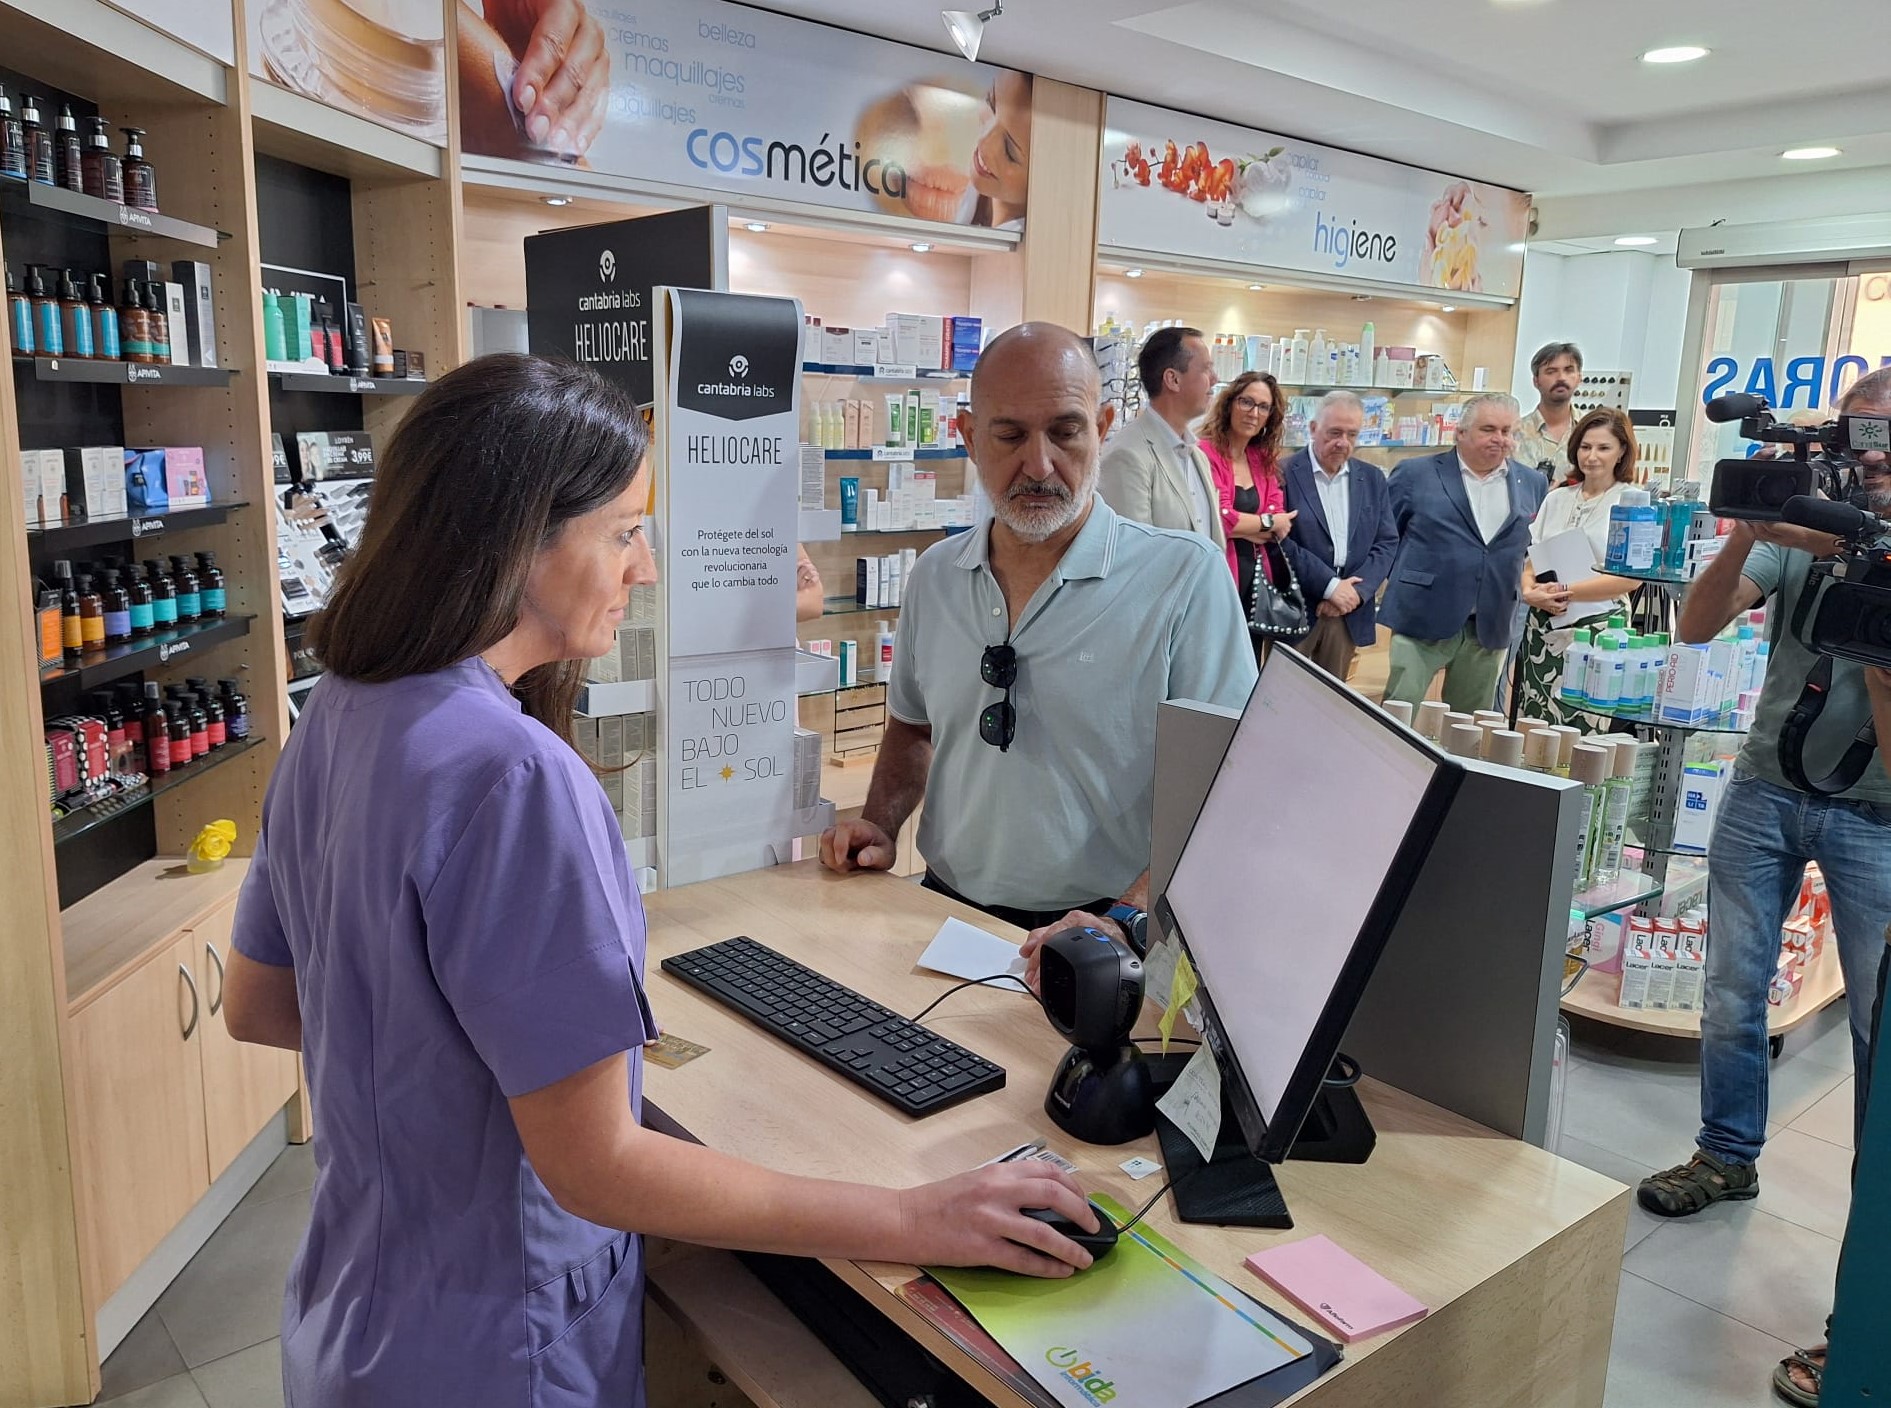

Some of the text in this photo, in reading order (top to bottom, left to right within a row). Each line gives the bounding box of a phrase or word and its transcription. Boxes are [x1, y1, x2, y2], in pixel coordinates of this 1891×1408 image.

[608, 26, 669, 52] cremas
[698, 18, 756, 49] belleza
[625, 52, 745, 94] maquillajes
[686, 127, 908, 200] cosmética
[1314, 210, 1397, 268] higiene
[578, 289, 641, 312] cantabria labs
[575, 320, 649, 363] HELIOCARE
[697, 382, 775, 399] cantabria labs
[350, 449, 373, 464] 3,99€
[688, 435, 783, 465] HELIOCARE
[697, 528, 774, 542] Protégete del sol
[681, 543, 788, 558] con la nueva tecnología
[704, 561, 767, 573] revolucionaria
[691, 575, 779, 592] que lo cambia todo
[682, 676, 746, 704] TODO
[712, 699, 786, 730] NUEVO
[682, 733, 739, 762] BAJO
[681, 755, 784, 791] EL SOL
[1583, 919, 1596, 953] Lacer
[1591, 922, 1605, 953] Gingi
[1626, 961, 1649, 969] Lacer
[1651, 962, 1674, 971] Lacer
[1676, 962, 1700, 972] Lacer
[1067, 1361, 1117, 1405] bida
